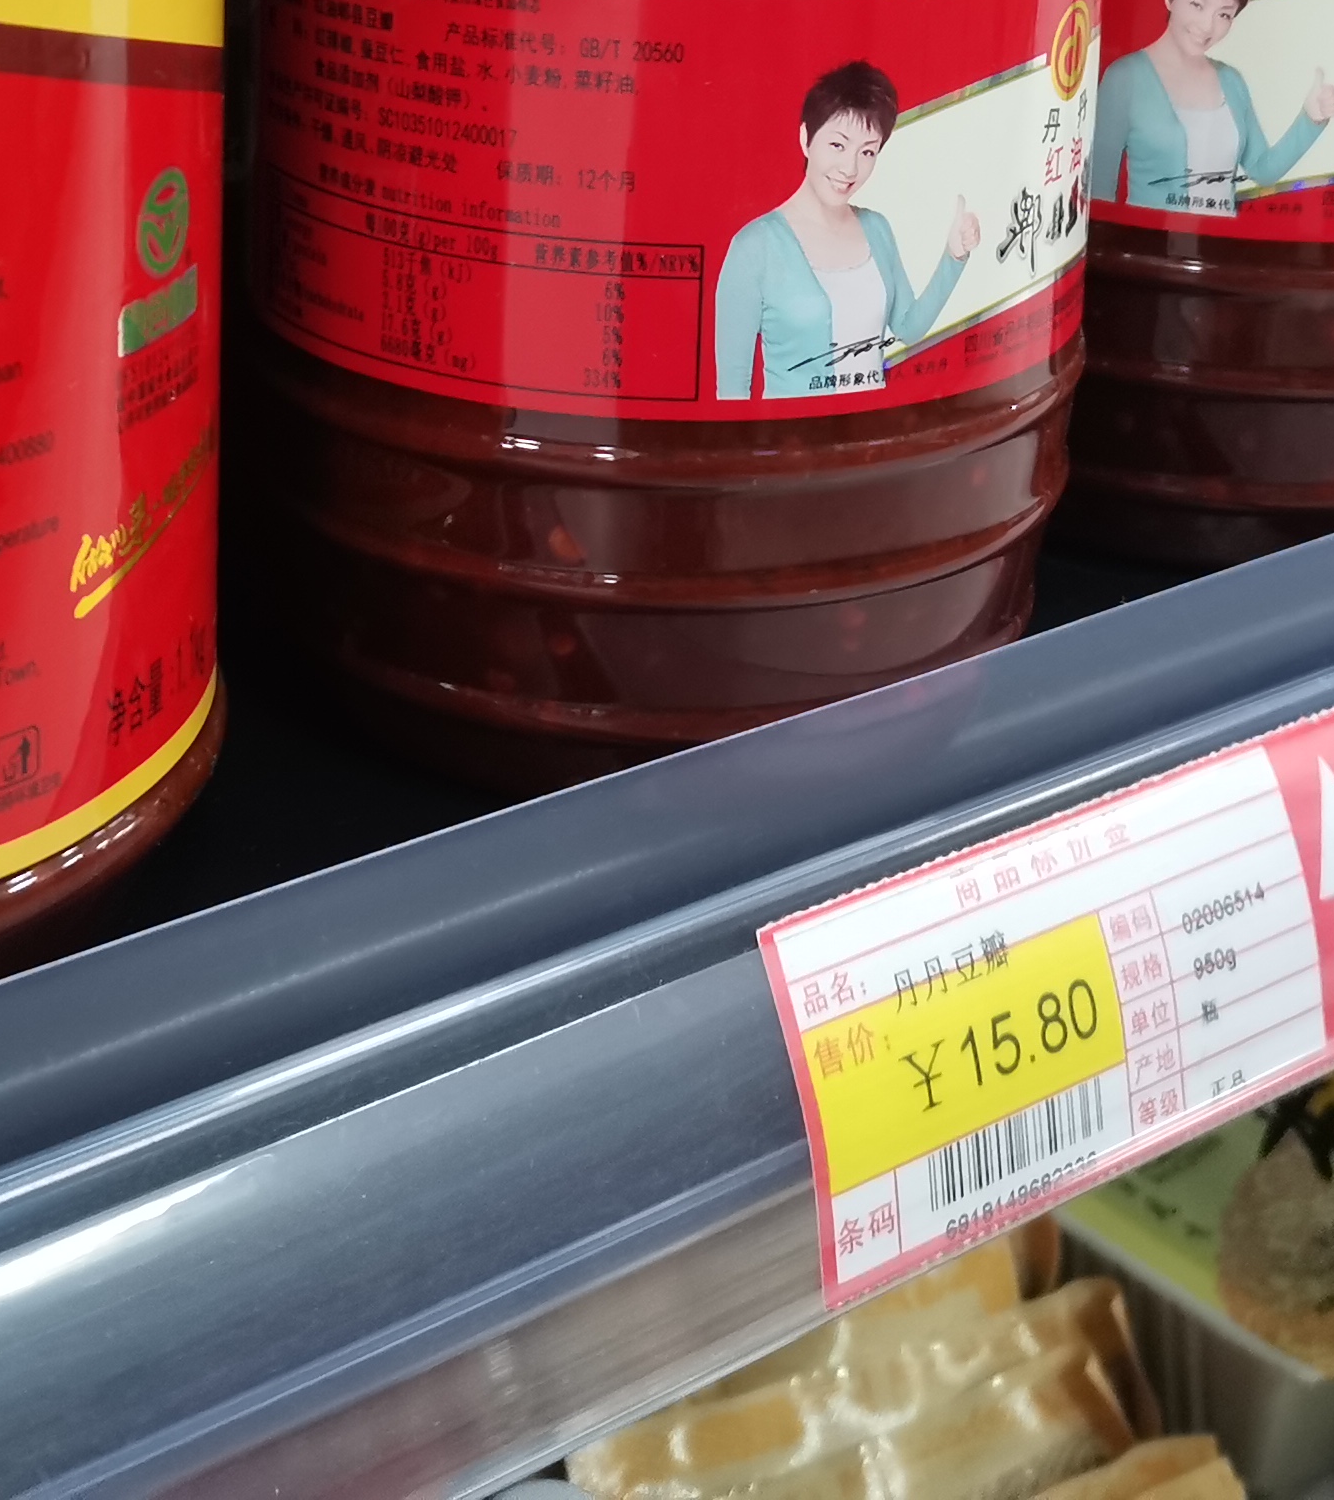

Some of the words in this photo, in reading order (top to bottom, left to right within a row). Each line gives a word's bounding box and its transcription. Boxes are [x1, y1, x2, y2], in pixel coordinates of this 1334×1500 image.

[1109, 904, 1153, 942] 编码
[1180, 881, 1266, 934] 02006514
[893, 929, 1010, 1014] 丹丹豆瓣
[1121, 951, 1163, 991] 规格
[1193, 948, 1237, 980] 950g
[1131, 999, 1171, 1036] 单位
[898, 977, 1098, 1113] ¥15.80
[1134, 1044, 1177, 1085] 产地
[1138, 1087, 1180, 1125] 等级
[836, 1200, 897, 1258] 条码
